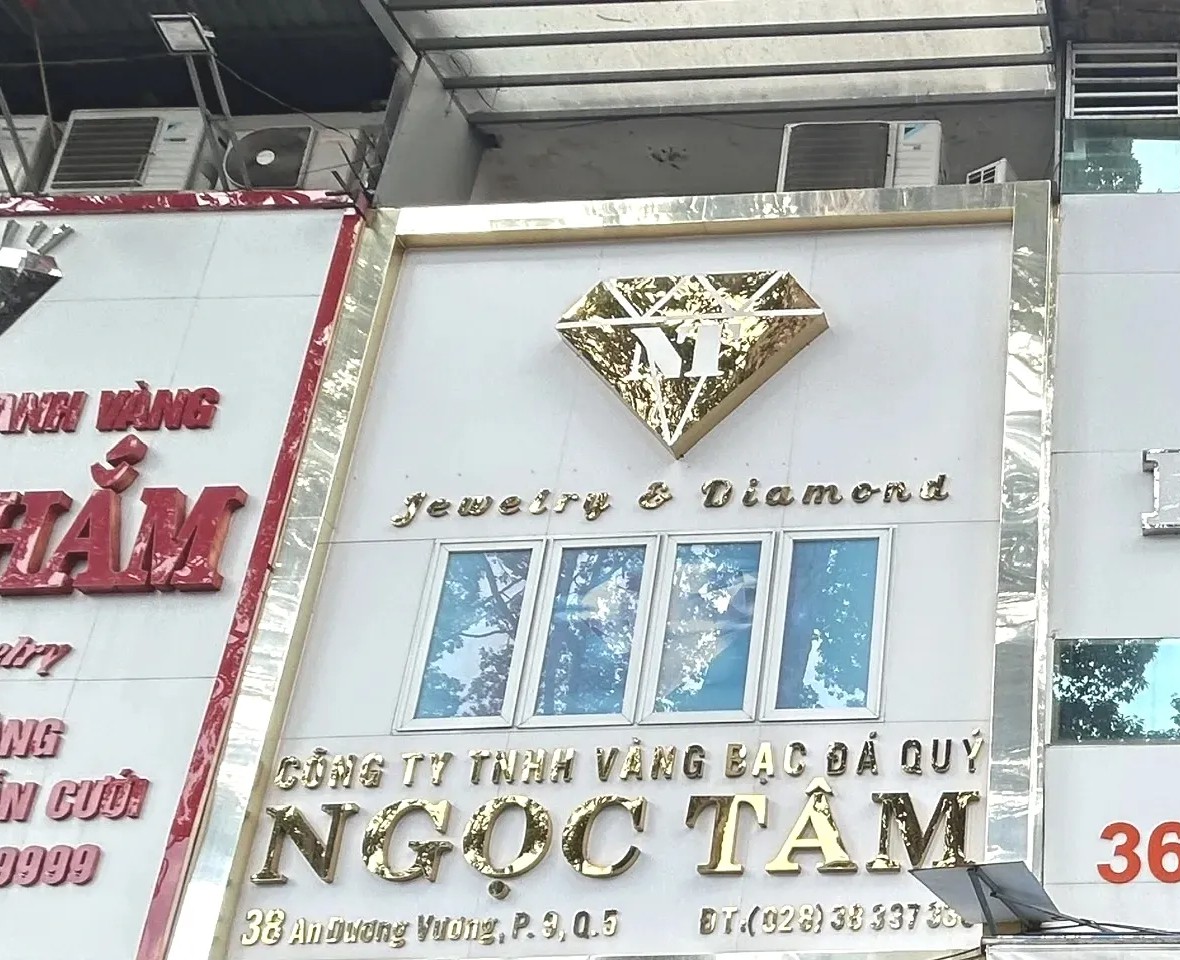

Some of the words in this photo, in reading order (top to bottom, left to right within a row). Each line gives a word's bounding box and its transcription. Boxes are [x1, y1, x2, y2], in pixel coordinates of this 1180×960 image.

[96, 380, 220, 432] VÀNG
[638, 481, 674, 510] &
[701, 473, 951, 509] Diamond
[0, 717, 66, 758] NG
[273, 747, 385, 790] CÔNG
[401, 751, 456, 787] TY
[468, 748, 576, 785] TNHH
[596, 736, 706, 783] VÀNG
[725, 740, 807, 785] BẠC
[826, 731, 879, 776] ĐÁ
[901, 728, 984, 774] QUÝ
[250, 794, 647, 900] NGỌC
[686, 776, 981, 875] TÂM
[241, 908, 286, 946] 38
[289, 917, 323, 945] An
[325, 915, 410, 948] Dương
[417, 914, 505, 945] Vương,
